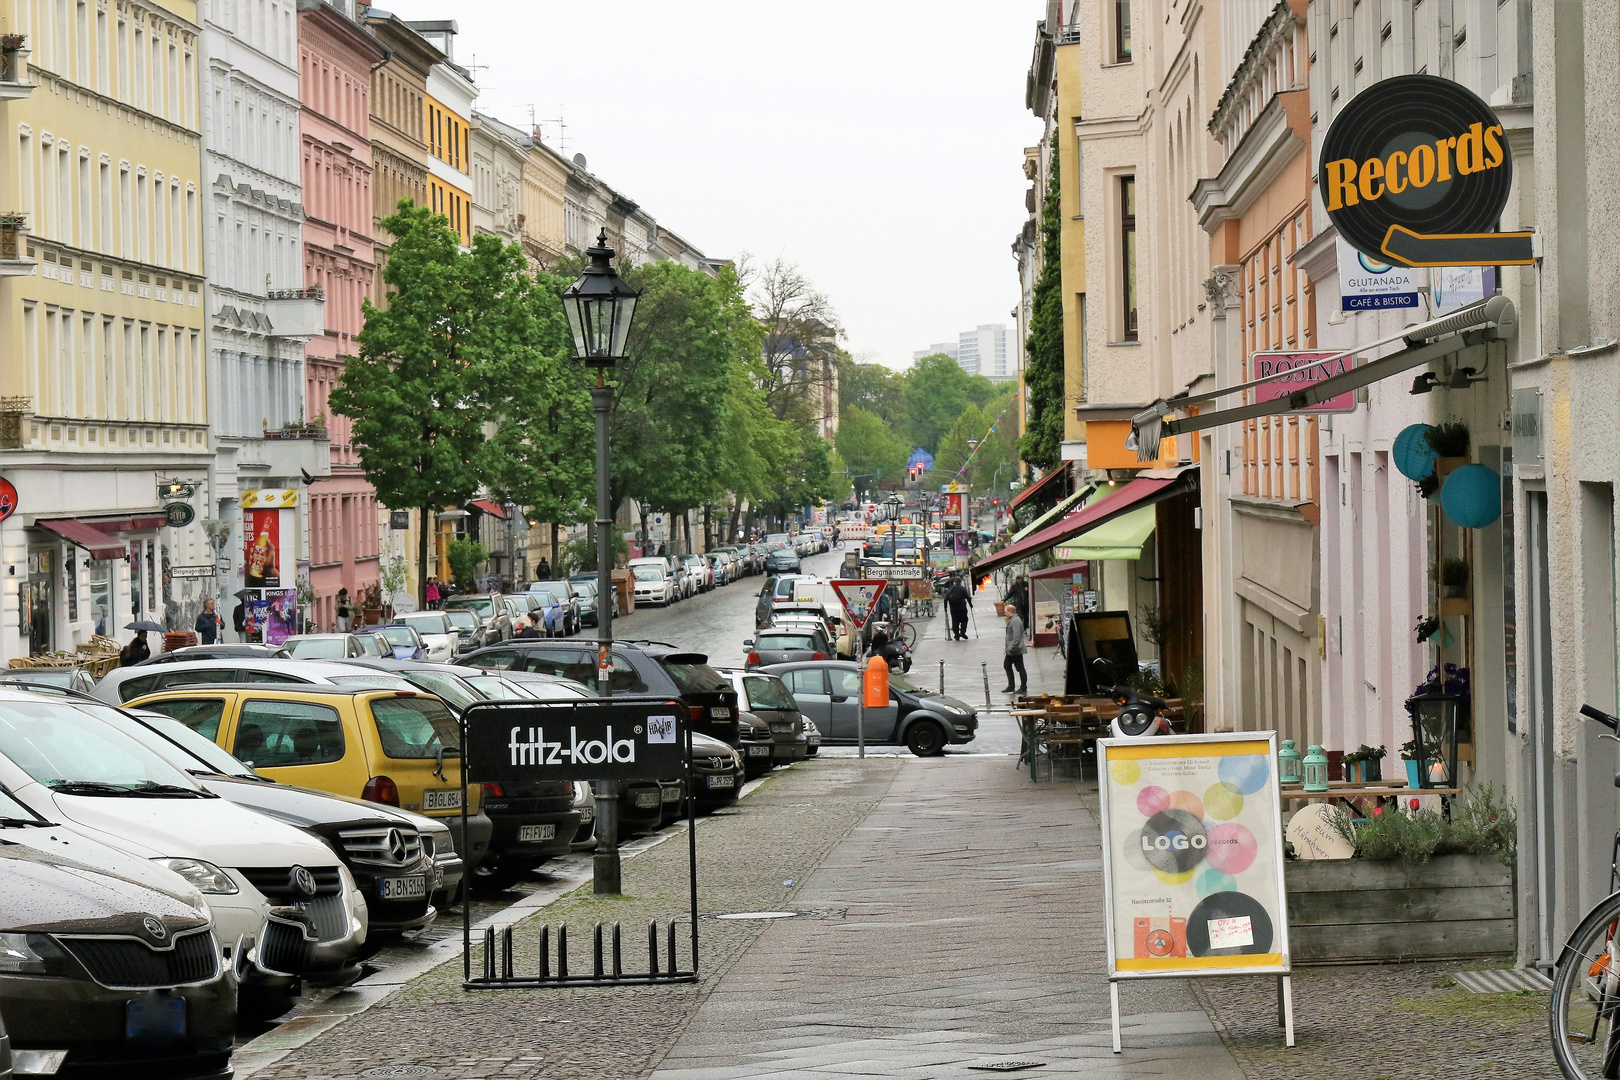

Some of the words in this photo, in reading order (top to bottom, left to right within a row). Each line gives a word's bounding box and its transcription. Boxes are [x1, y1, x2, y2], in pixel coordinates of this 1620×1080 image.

[1325, 122, 1504, 211] Records
[1348, 277, 1410, 287] GLUTANADA
[1350, 297, 1371, 307] CAFÉ
[1374, 298, 1380, 306] &
[1383, 296, 1411, 306] BISTRO
[1260, 357, 1347, 382] ROSINA
[867, 567, 920, 577] Bergmannstraße
[428, 794, 434, 807] B
[1315, 825, 1334, 843] zum
[1142, 834, 1207, 851] LOGO
[385, 880, 390, 896] B
